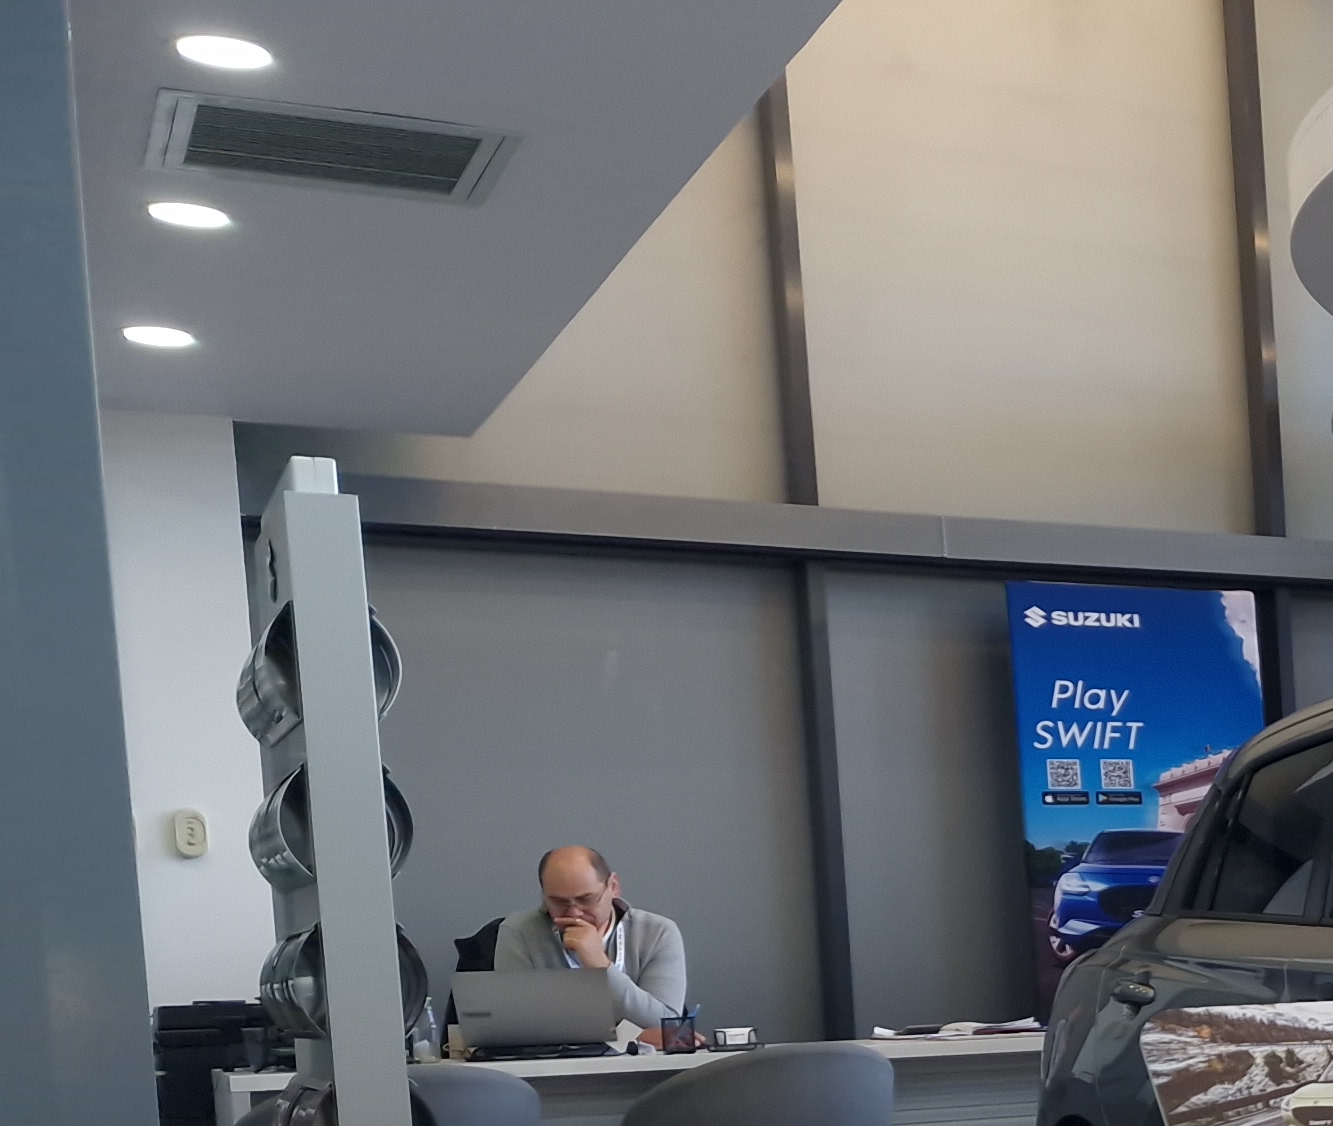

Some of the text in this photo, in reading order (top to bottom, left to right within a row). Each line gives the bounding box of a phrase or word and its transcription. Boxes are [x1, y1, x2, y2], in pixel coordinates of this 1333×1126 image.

[1051, 610, 1141, 628] SUZUKI
[1051, 680, 1130, 717] Play
[1033, 720, 1145, 750] SWIFT
